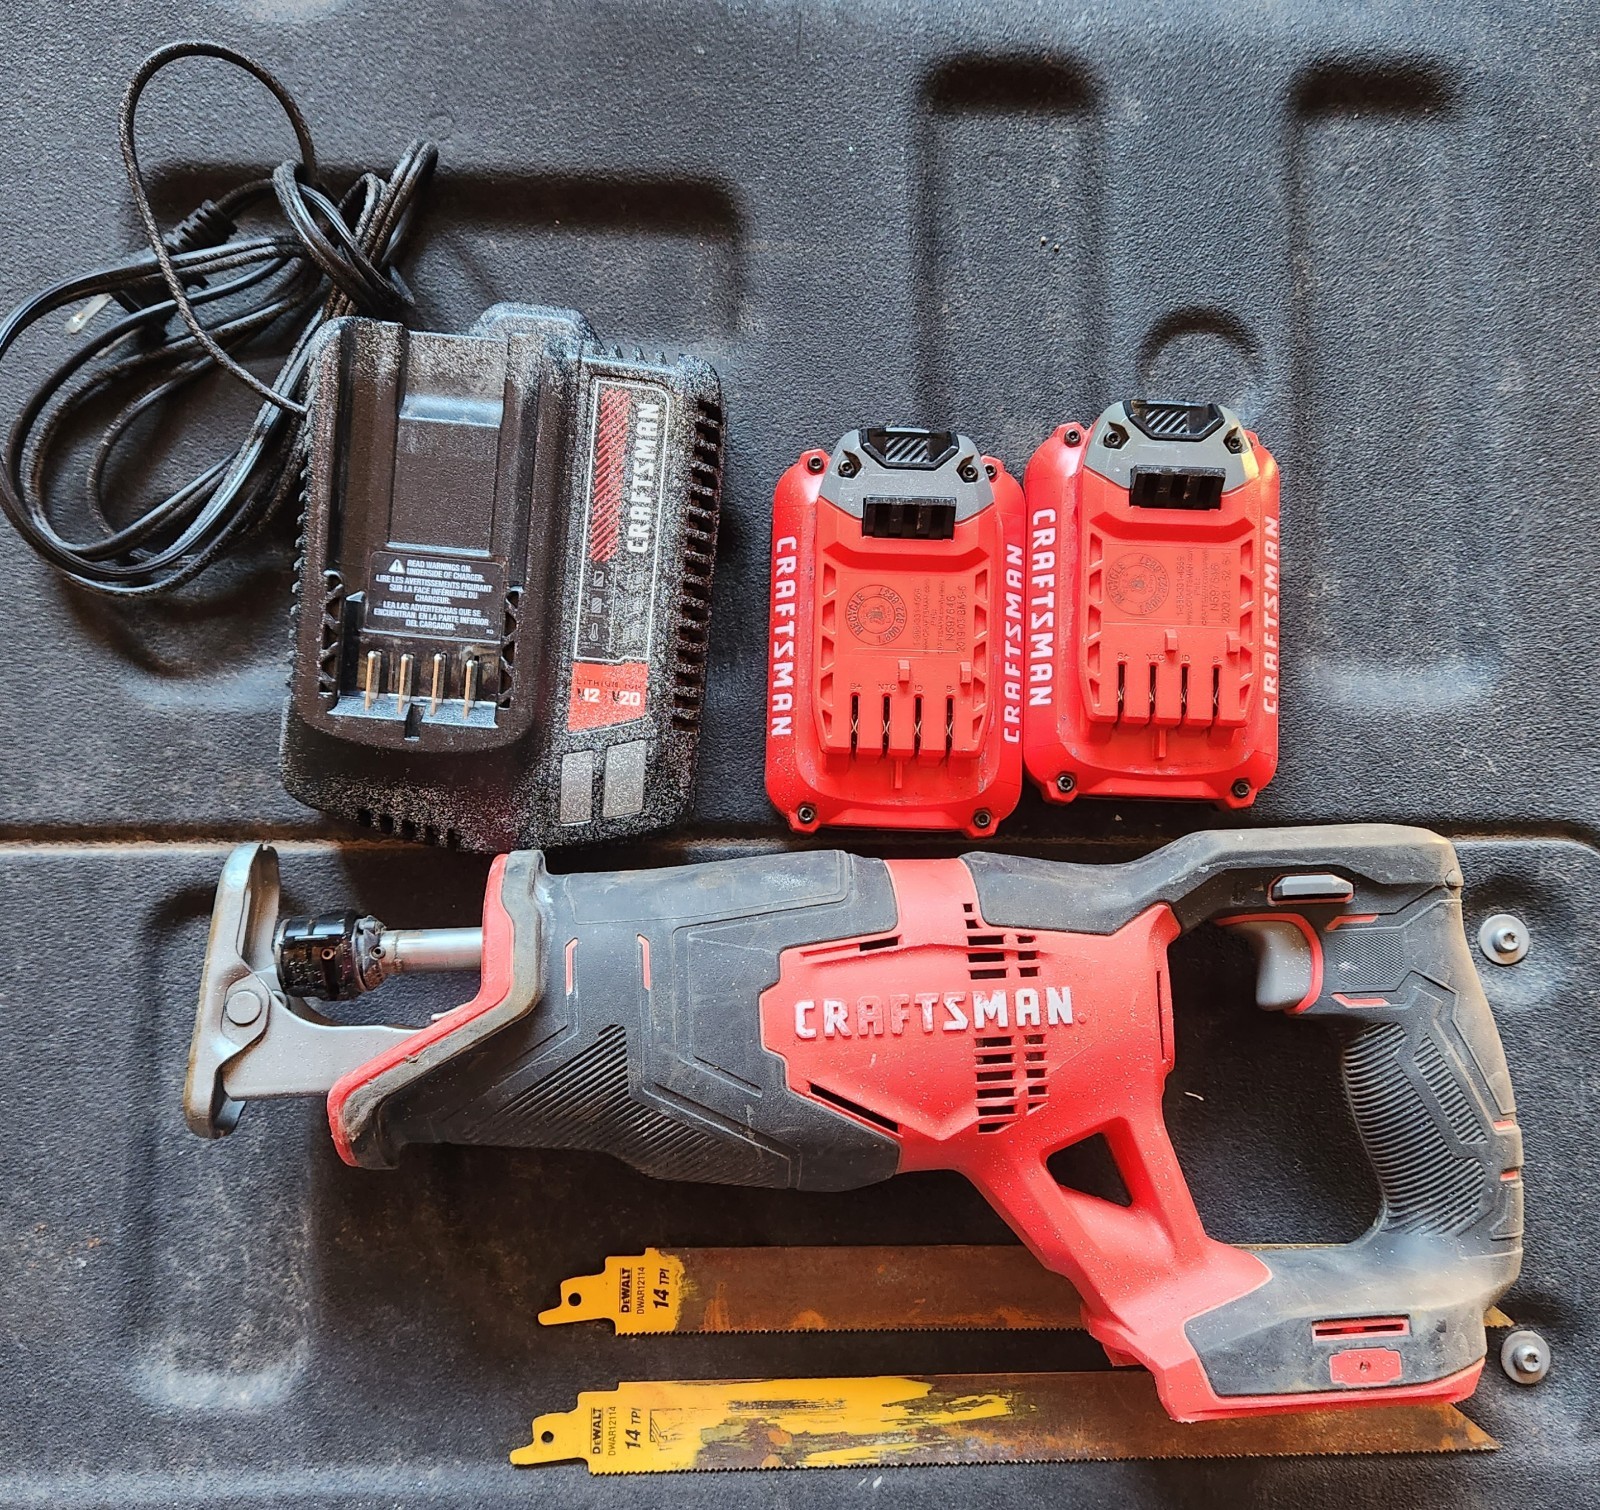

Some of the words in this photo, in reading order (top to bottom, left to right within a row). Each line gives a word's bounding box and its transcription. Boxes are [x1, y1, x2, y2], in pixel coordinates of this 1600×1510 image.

[626, 402, 660, 552] CRAFTSMAN
[406, 559, 425, 568] READ
[425, 561, 460, 571] WARNINGS
[406, 567, 443, 578] UNDERSIDE
[443, 570, 453, 578] OF
[453, 571, 485, 582] CHARGER.
[376, 574, 391, 583] LIRE
[392, 576, 405, 584] LES
[405, 577, 460, 590] AVERTISSEMENTS
[461, 582, 493, 593] FIGURANT
[389, 583, 403, 592] SUR
[404, 585, 413, 593] LA
[413, 585, 430, 594] FACE
[468, 591, 478, 599] DU
[382, 600, 396, 609] LEA
[397, 601, 410, 610] LAS
[410, 603, 458, 615] ADVERTENCIAS
[458, 608, 472, 616] QUE
[472, 609, 482, 617] SE
[414, 594, 452, 605] CHARGEUR.
[1029, 508, 1057, 707] CRAFTSMAN
[373, 607, 416, 619] ENCUENTRAN
[418, 611, 428, 620] EN
[428, 612, 438, 620] LA
[438, 613, 459, 623] PARTE
[460, 616, 489, 626] INFERIOR
[847, 592, 865, 636] RECYCLE
[946, 595, 956, 641] N597646
[1263, 515, 1279, 715] CRAFTSMAN
[405, 619, 418, 627] DEL
[418, 620, 456, 631] CARGADOR.
[771, 536, 797, 736] CRAFTSMAN
[957, 632, 966, 653] 2019
[1003, 544, 1023, 744] CRAFTSMAN
[878, 682, 896, 691] NTC
[794, 986, 1073, 1039] CRAFTSMAN
[659, 1267, 670, 1285] TPI
[636, 1266, 646, 1315] DWAR12114
[652, 1288, 670, 1309] 14
[630, 1407, 641, 1425] TPI
[607, 1406, 617, 1456] DWAR12114
[625, 1428, 641, 1450] 14
